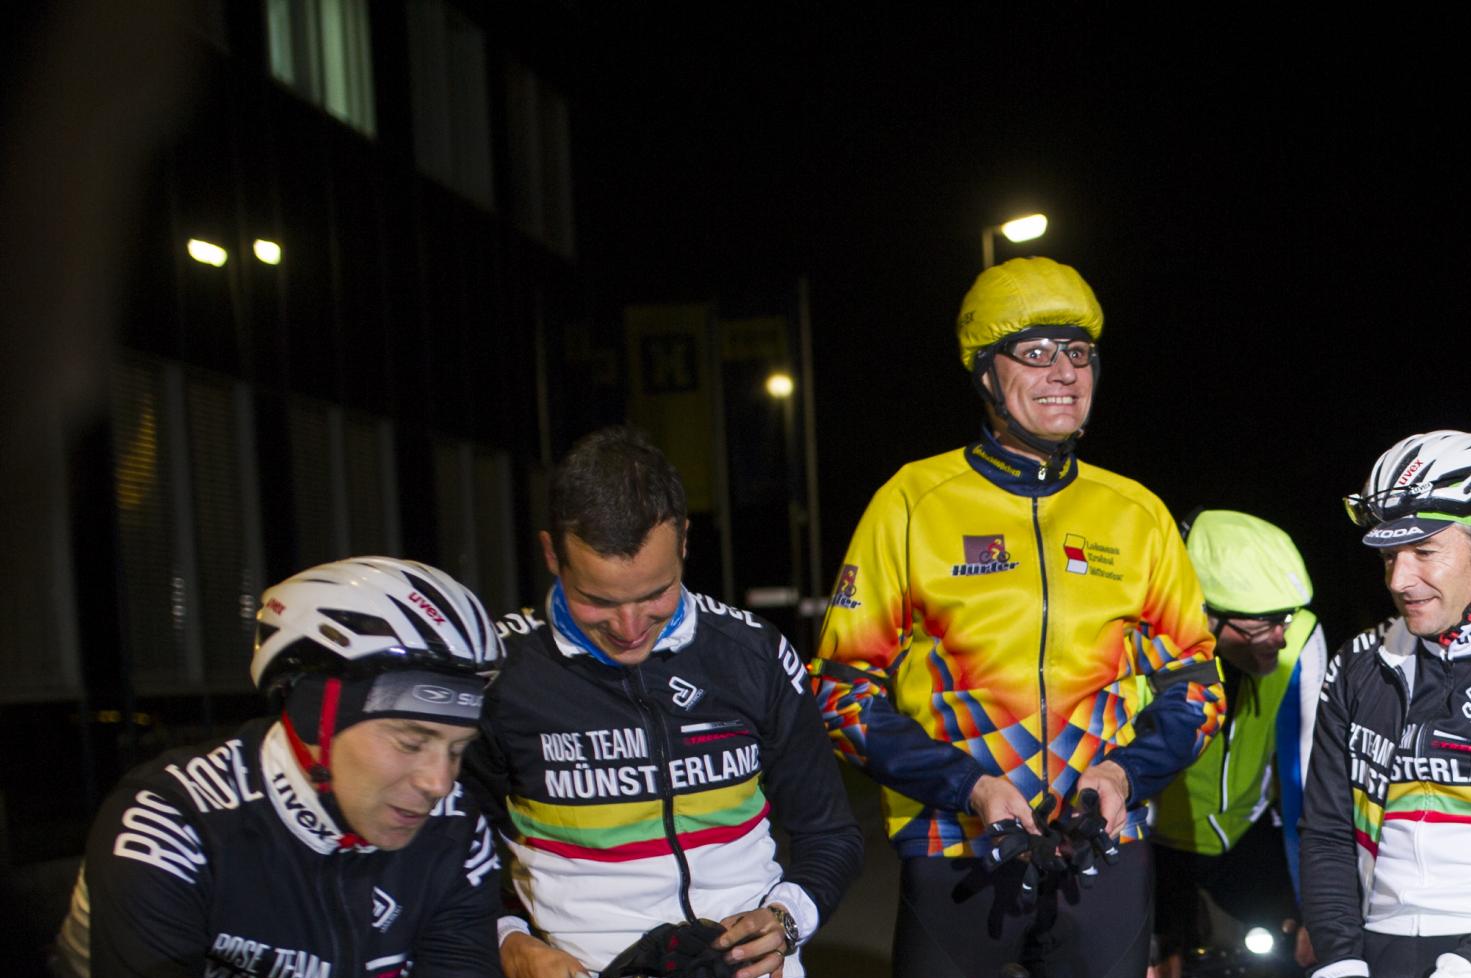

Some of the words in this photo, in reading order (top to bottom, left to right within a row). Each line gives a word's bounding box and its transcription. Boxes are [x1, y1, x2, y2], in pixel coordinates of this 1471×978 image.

[1397, 459, 1424, 485] uvex
[408, 591, 447, 626] uvex
[541, 732, 587, 763] ROSE
[586, 728, 649, 761] TEAM
[272, 773, 336, 841] uvex
[212, 933, 271, 974] ROSE
